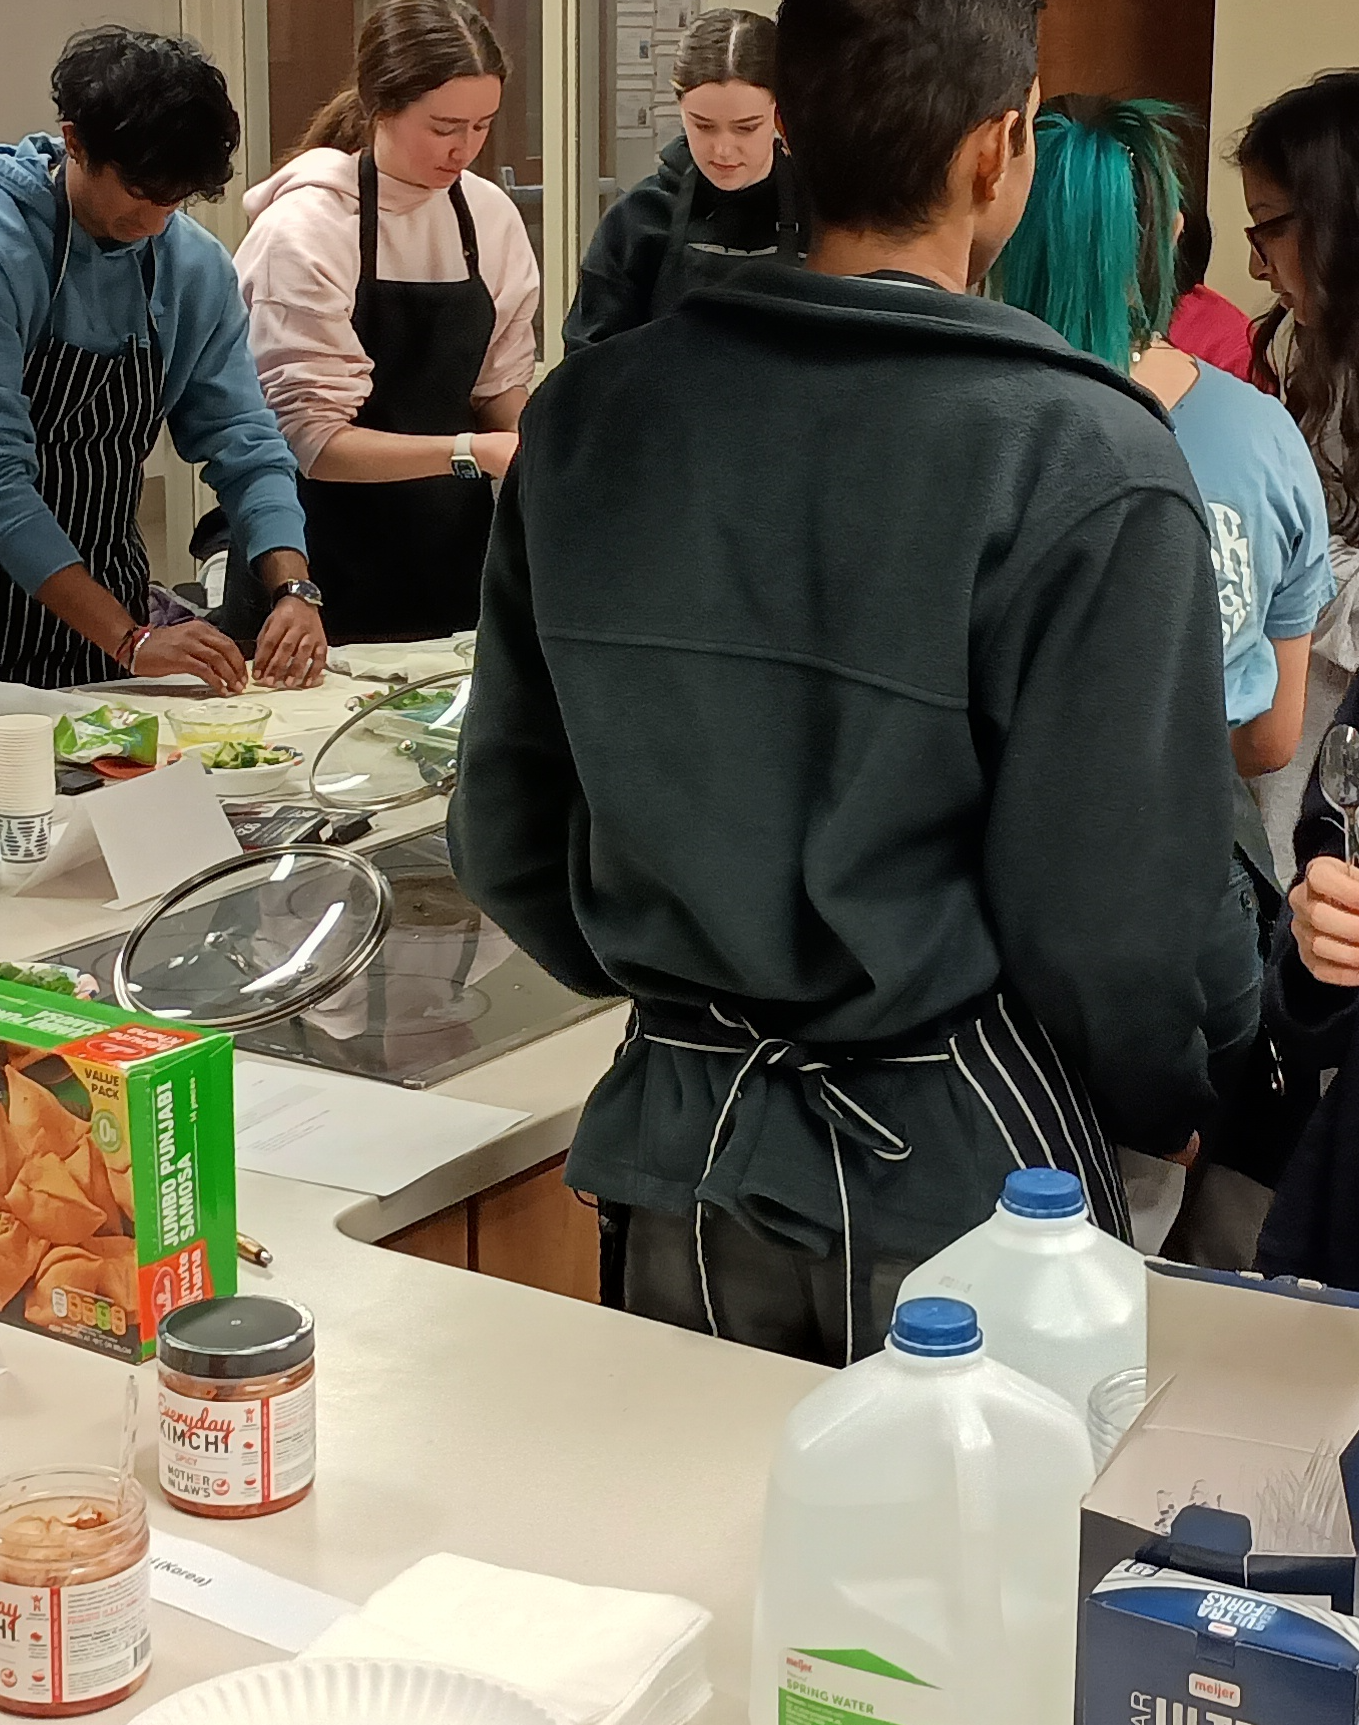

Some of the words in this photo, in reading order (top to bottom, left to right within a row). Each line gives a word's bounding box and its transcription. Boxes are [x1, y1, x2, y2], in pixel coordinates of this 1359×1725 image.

[84, 1067, 120, 1088] VALUE
[91, 1084, 120, 1101] PACK
[155, 1079, 176, 1178] PUNJABI
[162, 1178, 179, 1248] JUMBO
[177, 1151, 196, 1243] SAMOSA
[177, 1251, 191, 1306] inute
[190, 1248, 204, 1301] hana
[158, 1391, 236, 1445] Everyday
[159, 1417, 230, 1454] KIMCHI
[167, 1464, 210, 1487] MOTHER
[167, 1476, 176, 1489] IN
[177, 1479, 211, 1499] LAW'S
[1196, 1603, 1258, 1631] ULTRA
[1202, 1591, 1267, 1618] FORKS
[786, 1656, 813, 1673] meijer
[786, 1678, 829, 1702] SPRING
[832, 1693, 875, 1715] WATER
[1193, 1679, 1236, 1700] meijer
